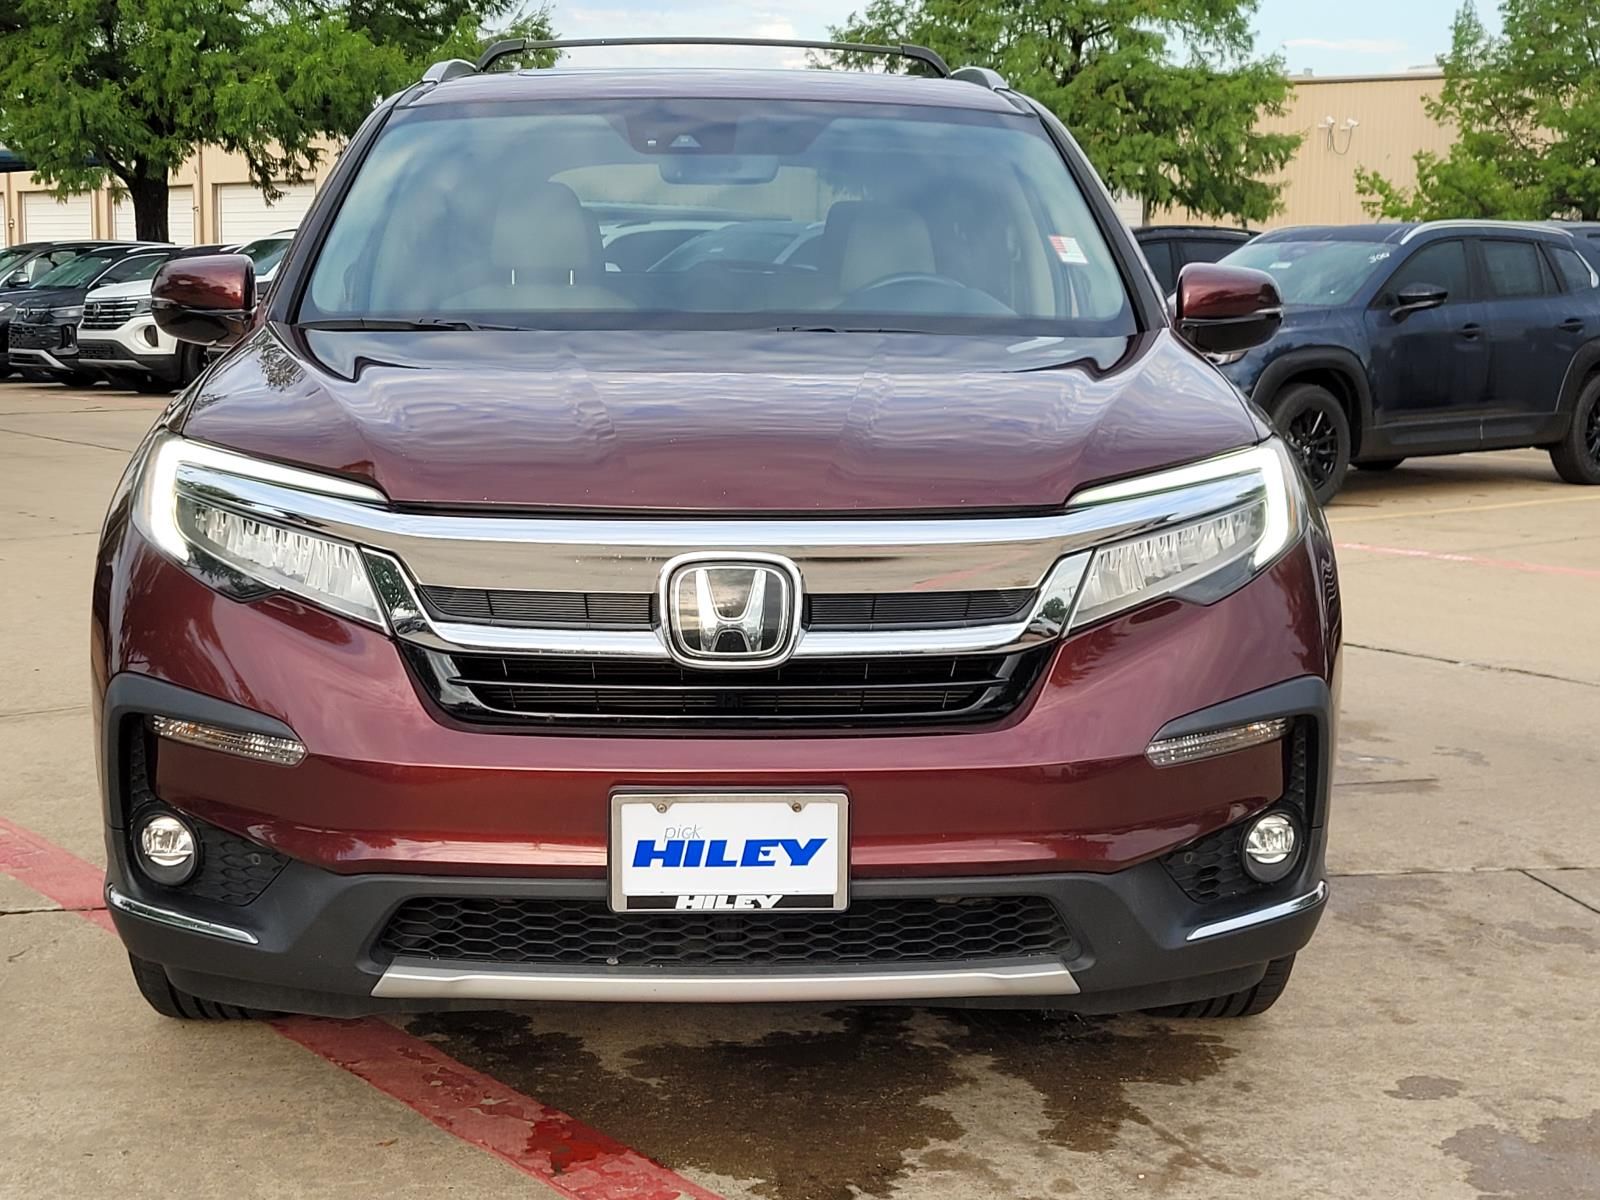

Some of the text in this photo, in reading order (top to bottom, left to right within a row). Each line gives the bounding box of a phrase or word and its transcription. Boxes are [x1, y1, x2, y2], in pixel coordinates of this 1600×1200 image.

[664, 824, 704, 843] pick
[632, 838, 828, 867] HILEY
[675, 894, 784, 910] HILEY
